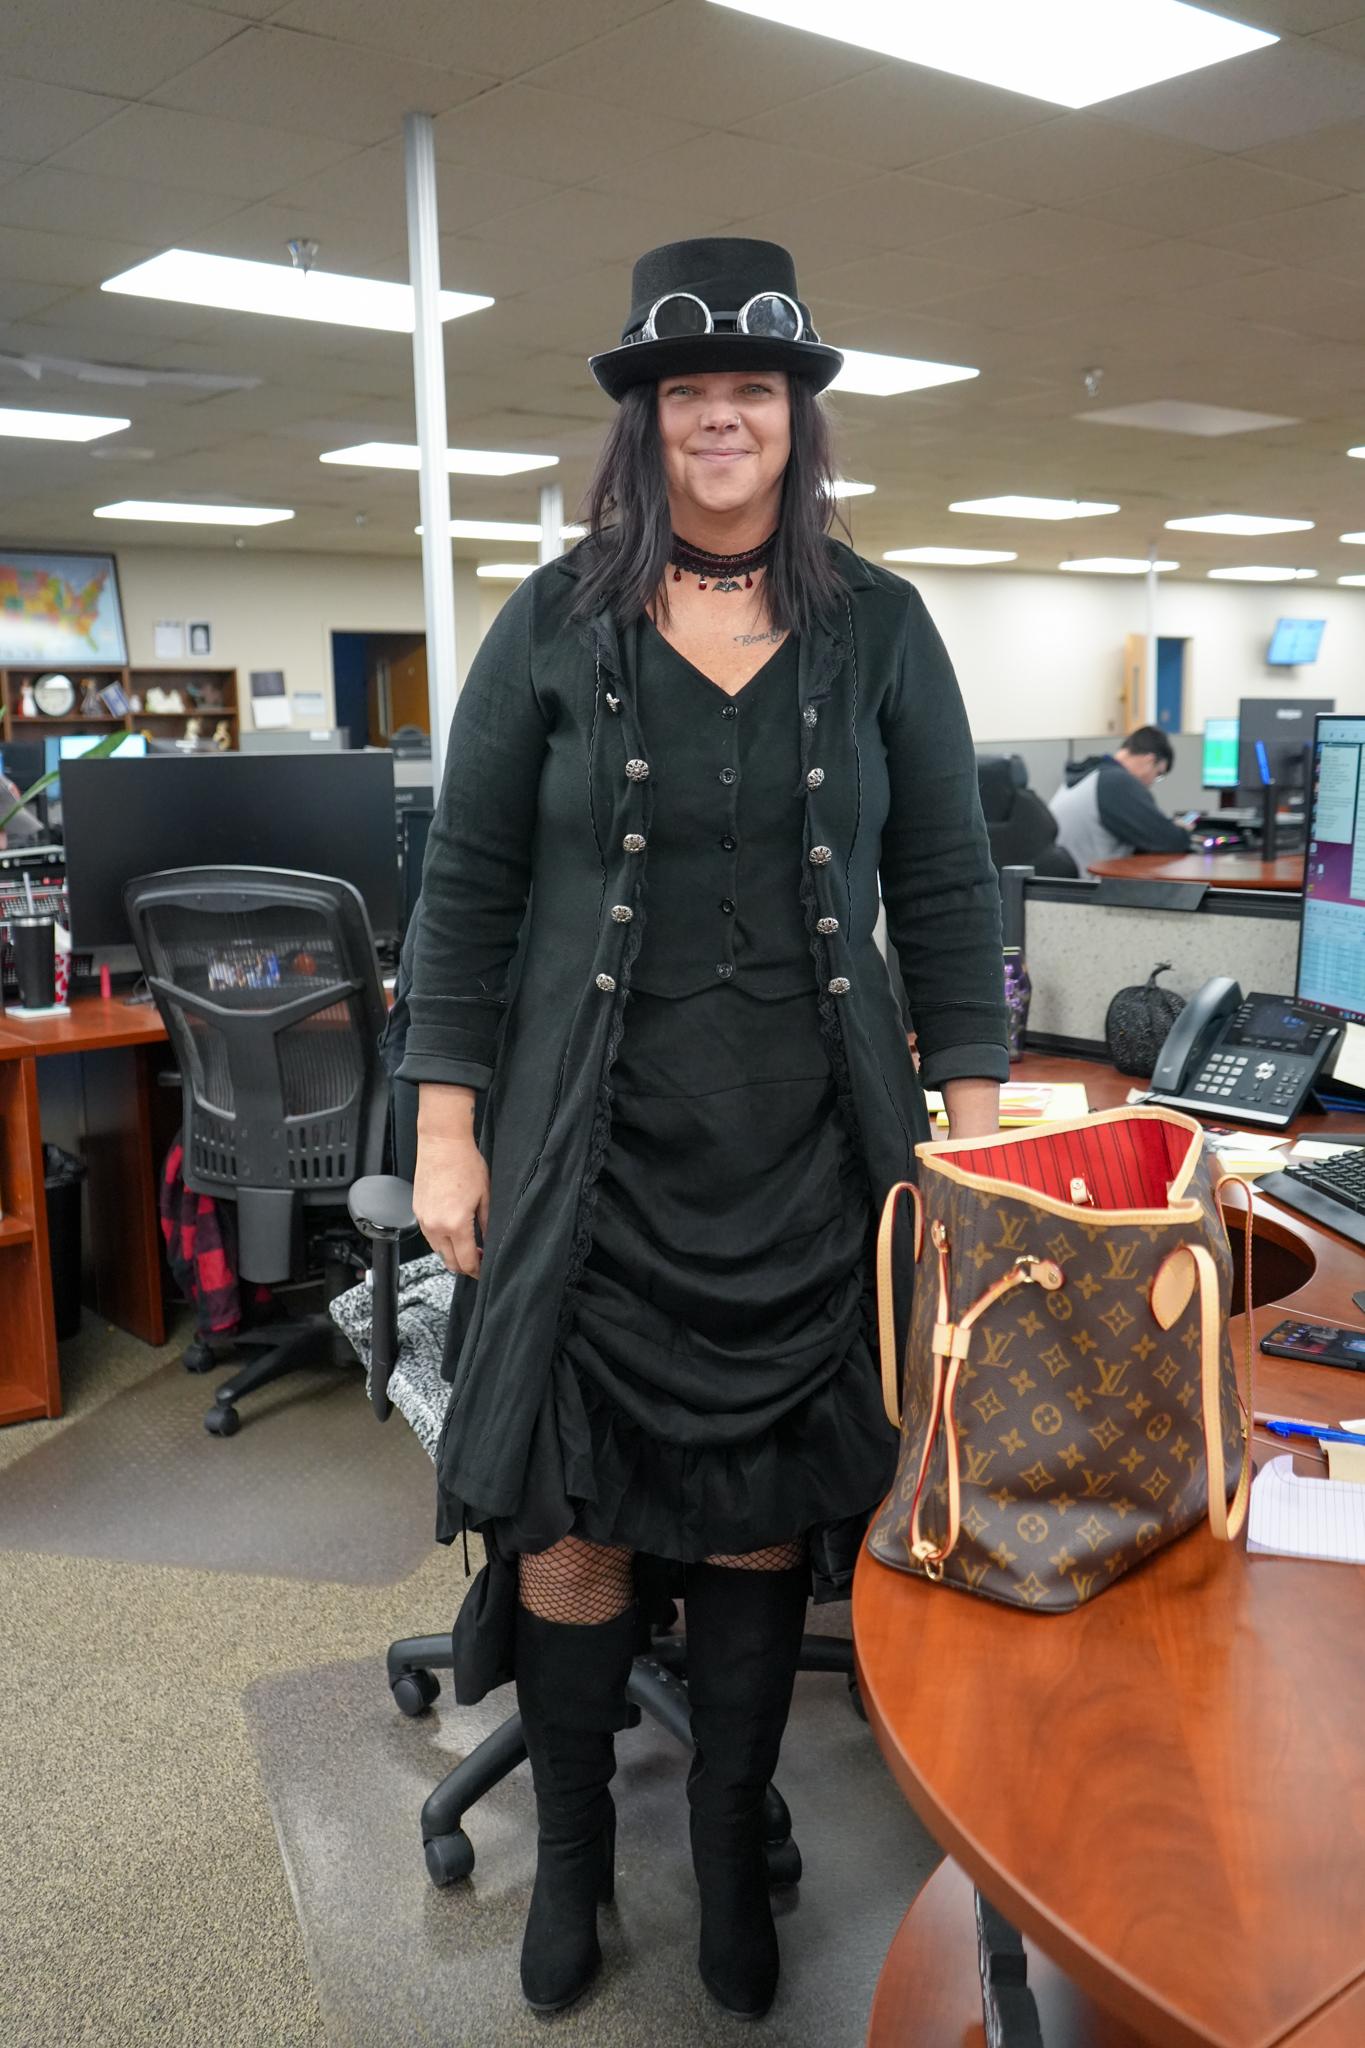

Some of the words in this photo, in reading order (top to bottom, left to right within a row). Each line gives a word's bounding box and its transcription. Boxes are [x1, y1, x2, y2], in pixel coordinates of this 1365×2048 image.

[1102, 1240, 1140, 1280] LV
[977, 1328, 1017, 1369] LV
[1091, 1357, 1132, 1397] LV
